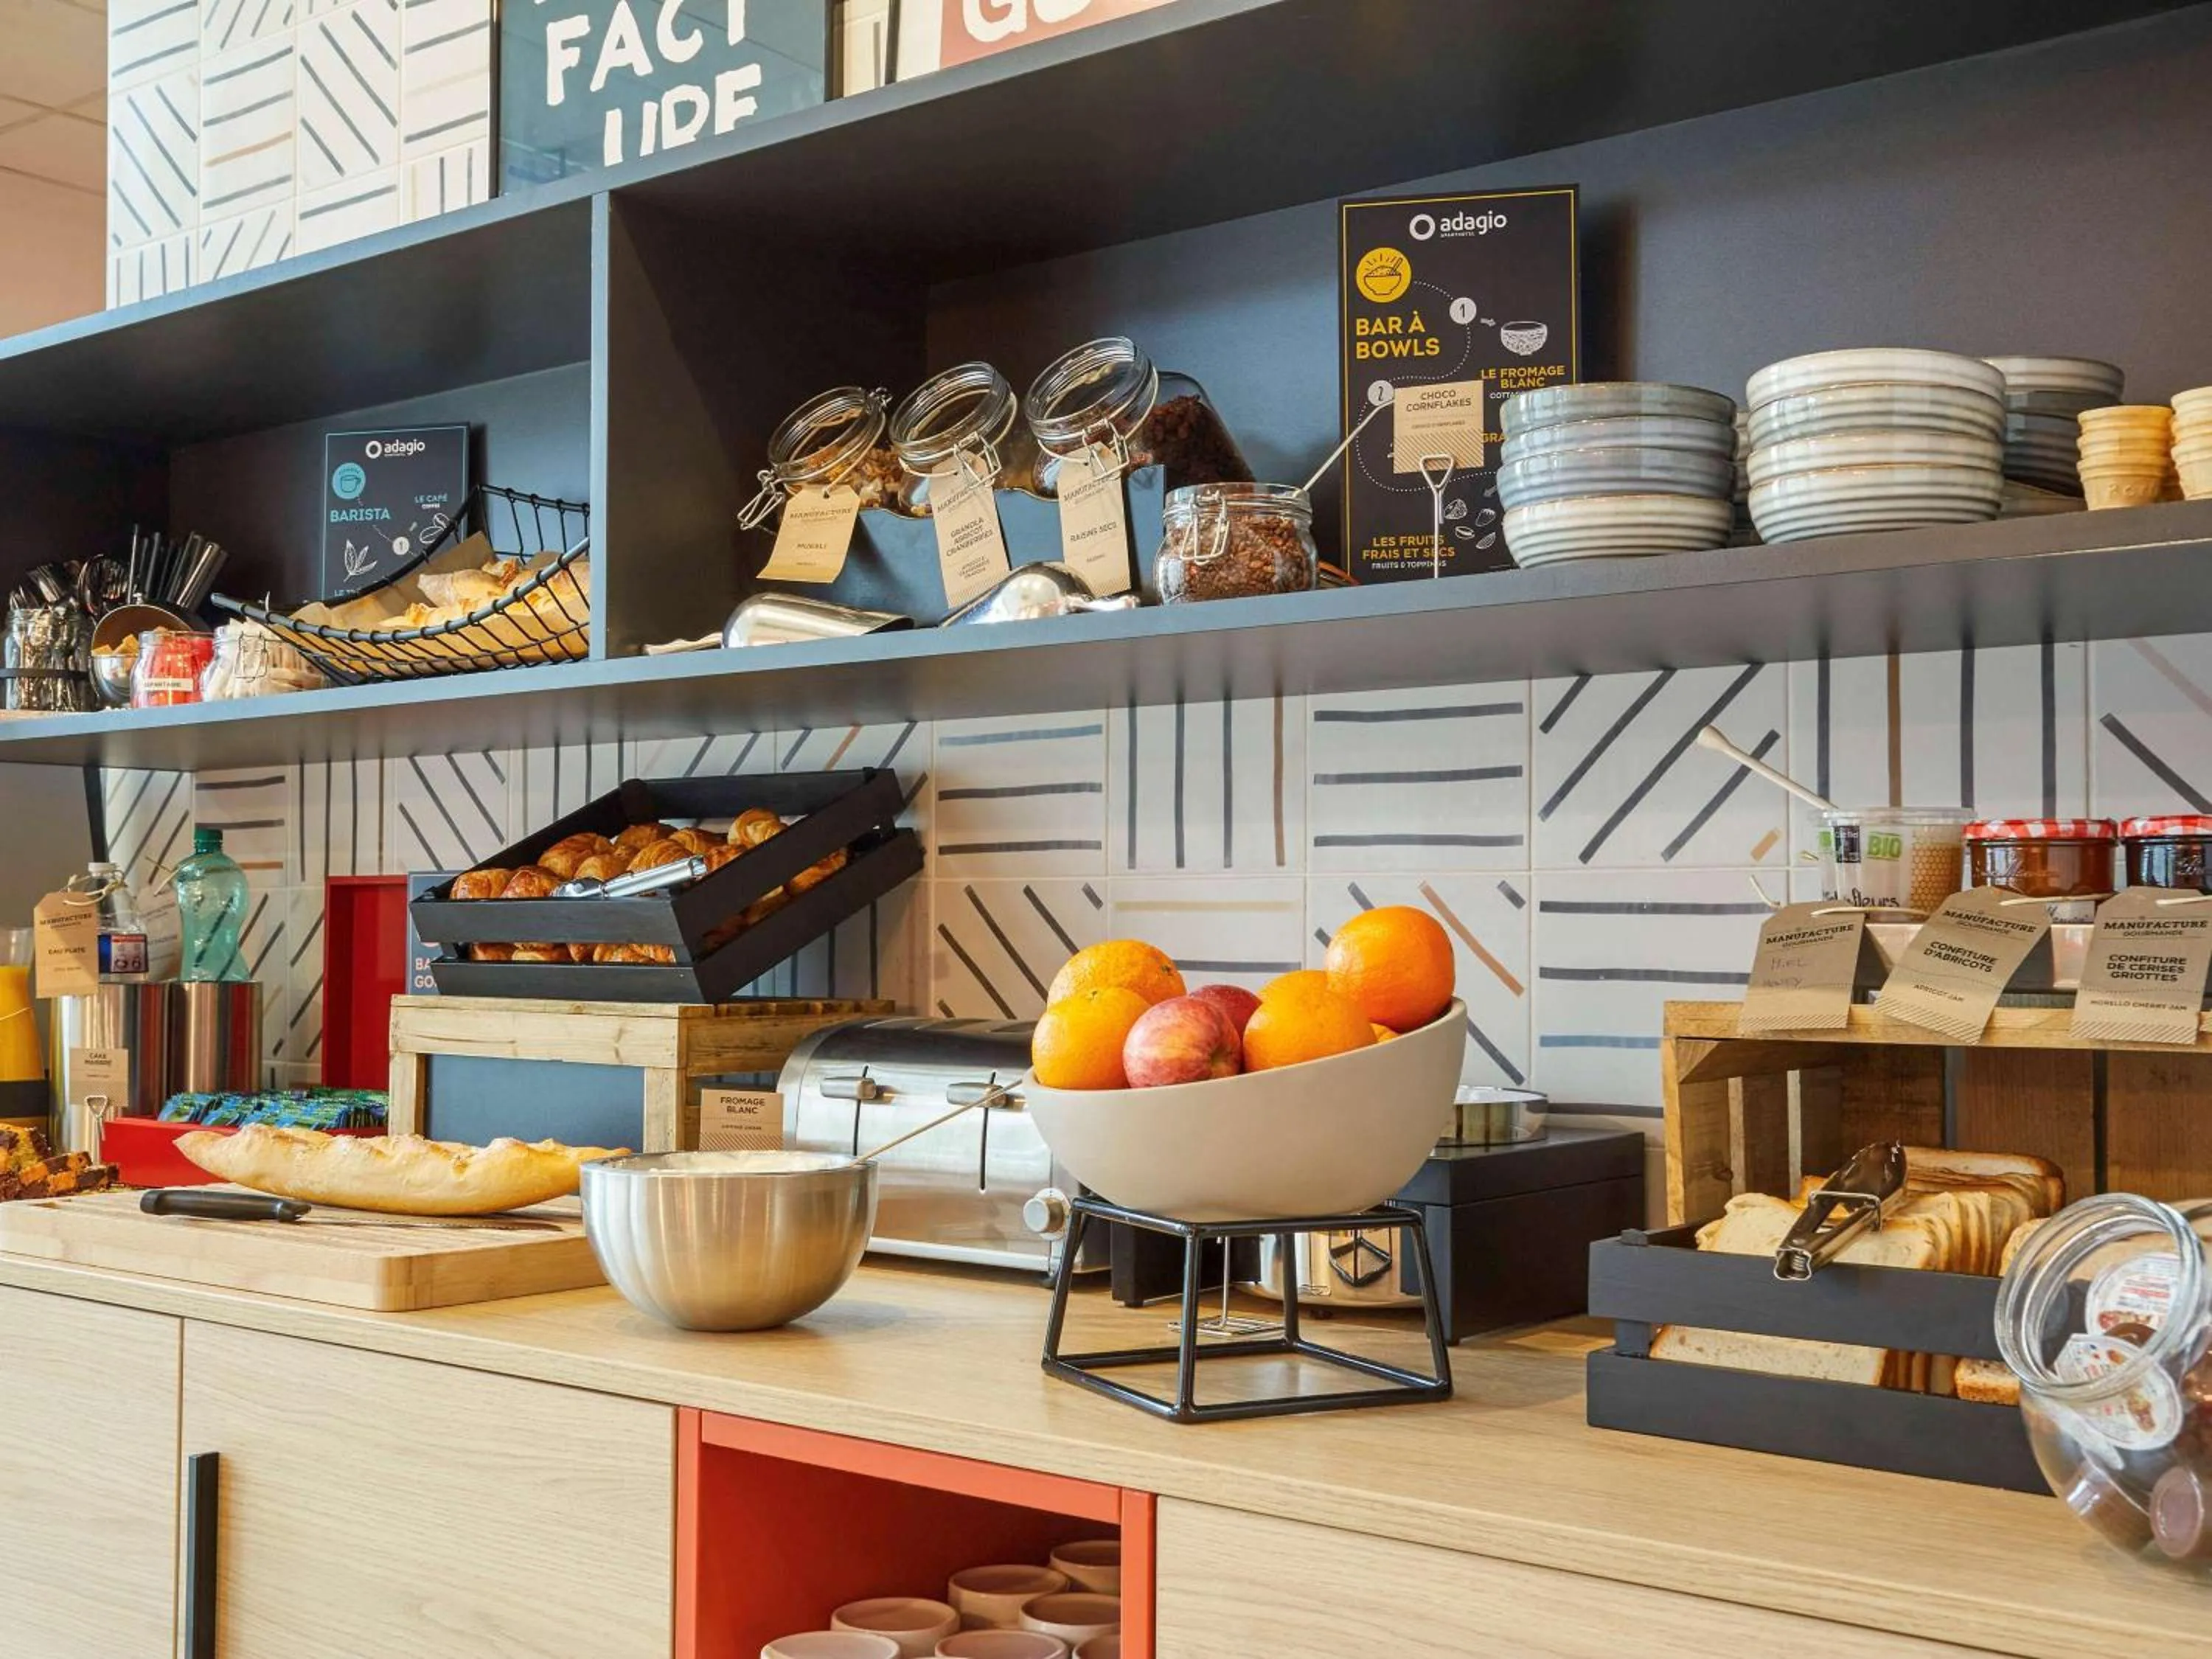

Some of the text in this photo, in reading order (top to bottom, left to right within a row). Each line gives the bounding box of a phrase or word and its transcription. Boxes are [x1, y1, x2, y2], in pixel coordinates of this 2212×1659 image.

[1440, 211, 1507, 234] adagio
[1356, 310, 1426, 336] BAR À
[1356, 338, 1440, 360] BOWLS
[1481, 365, 1566, 380] LE FROMAGE
[1500, 377, 1545, 389] BLANC
[1420, 389, 1457, 400] CHOCO
[1405, 397, 1472, 412] CORNFLAKES
[384, 439, 425, 456] adagio
[330, 507, 391, 523] BARISTA
[1372, 536, 1396, 547] LES
[1362, 549, 1400, 560] FRAIS
[1403, 548, 1419, 558] ET
[1869, 835, 1902, 858] BIO
[1942, 909, 2037, 933] MANUFACTURE
[1955, 921, 2012, 936] GOURMANDE
[2103, 919, 2208, 930] MANUFACTURE
[1765, 924, 1855, 945] MANUFACTURE
[1922, 948, 1994, 973] D'ABRICOTS
[1930, 941, 2000, 966] CONFITURE
[2108, 954, 2188, 965] CONFITURE
[2106, 962, 2186, 975] DE CERISES
[2110, 971, 2179, 982] GRIOTTES
[720, 1096, 766, 1107] FROMAGE
[726, 1105, 759, 1115] BLANC
